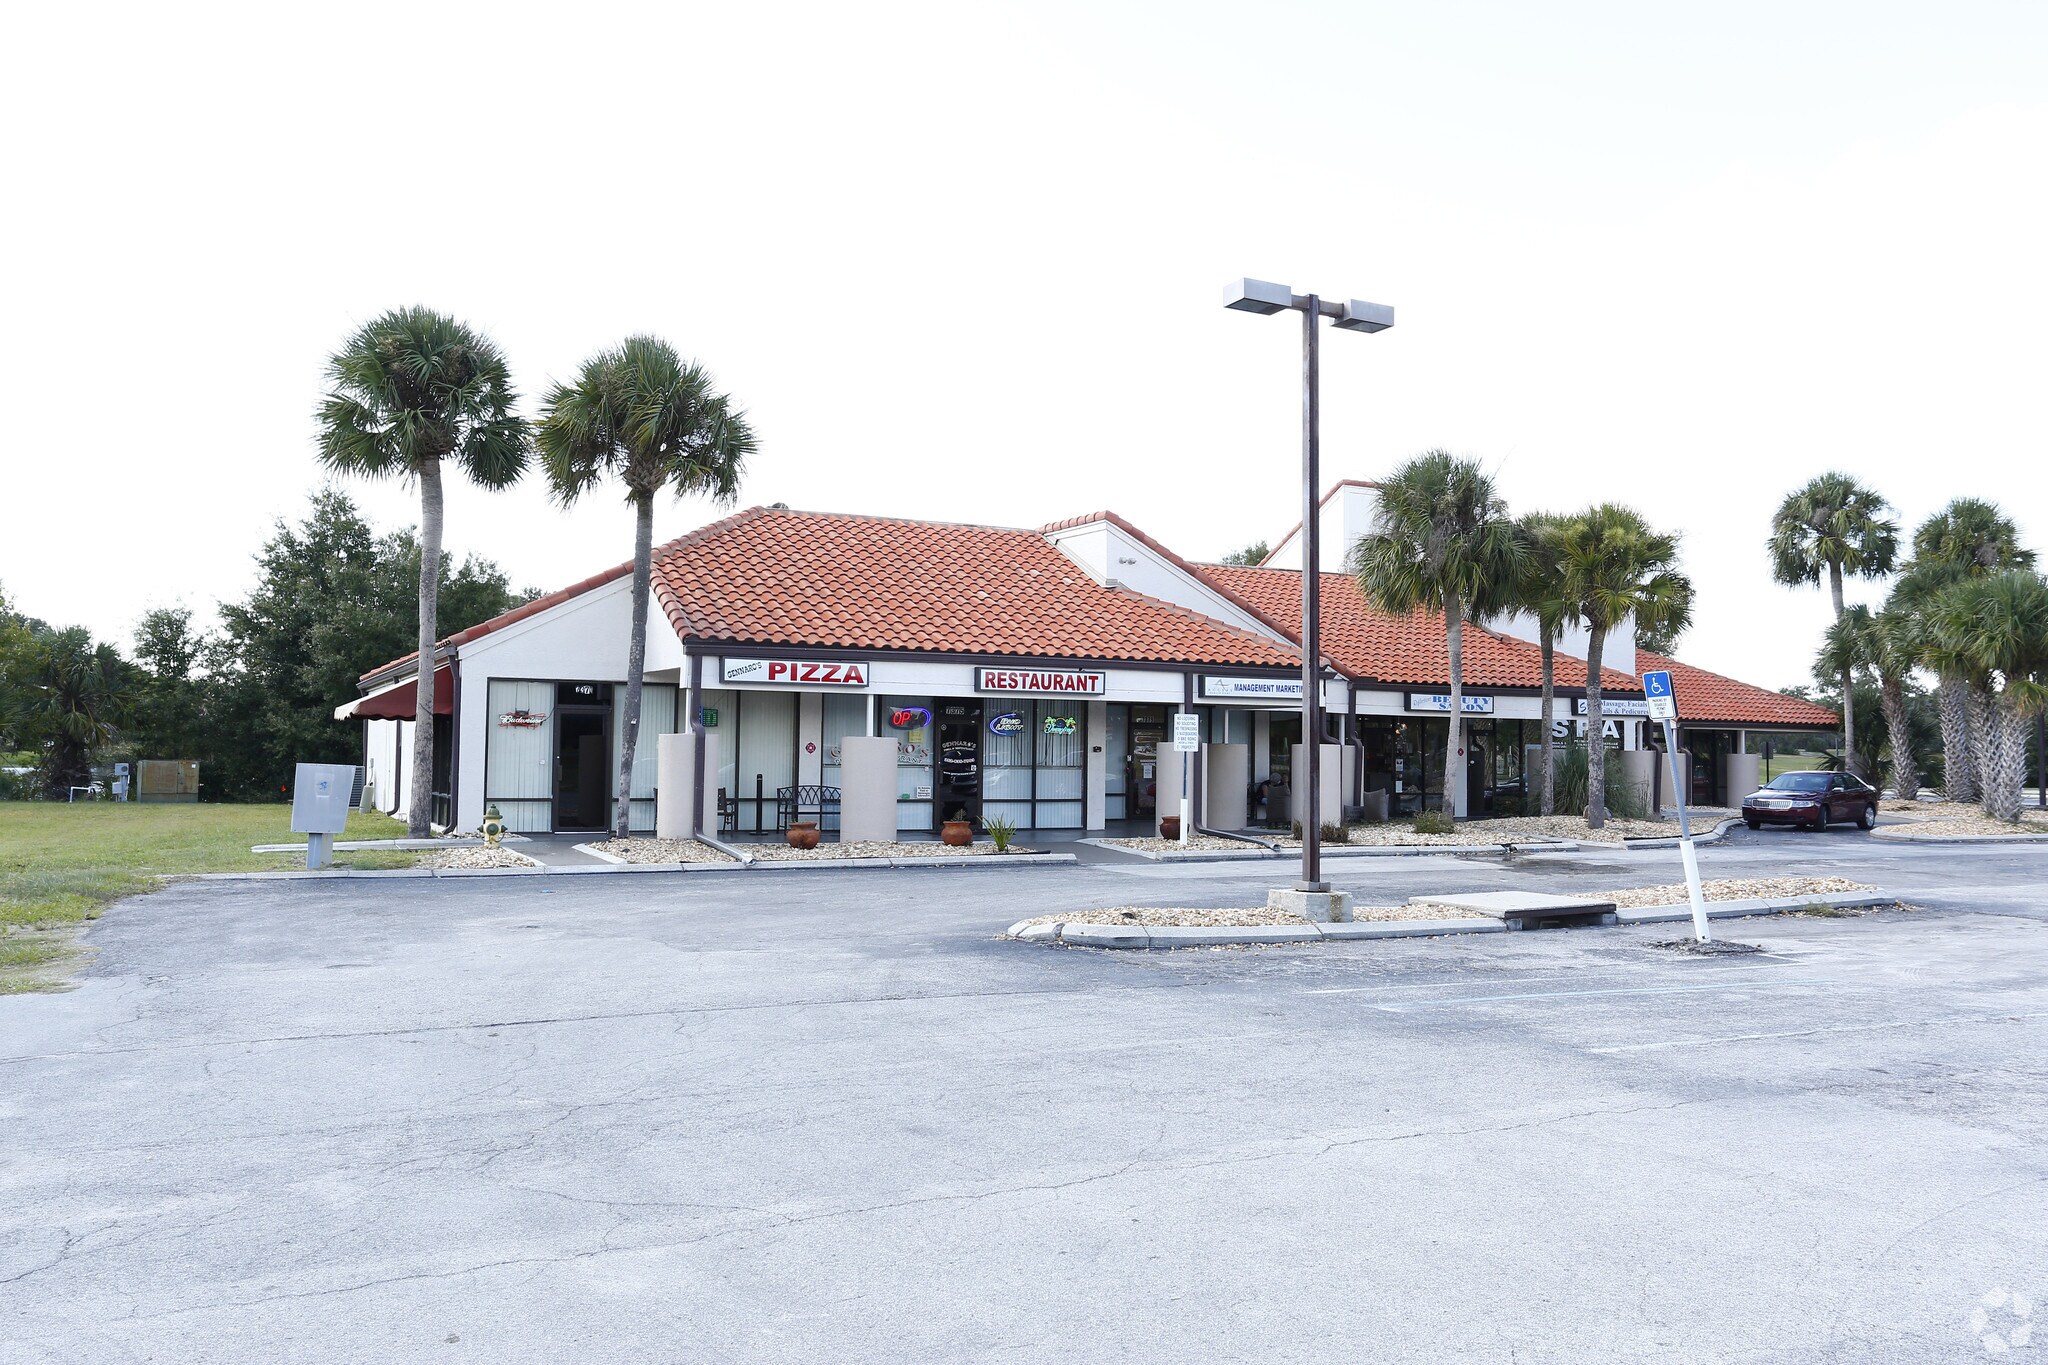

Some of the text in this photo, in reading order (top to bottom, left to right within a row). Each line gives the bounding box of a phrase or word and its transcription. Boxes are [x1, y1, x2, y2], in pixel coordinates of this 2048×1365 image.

[727, 661, 865, 684] GENNARO'S PIZZA
[984, 671, 1099, 692] RESTAURANT
[1234, 683, 1275, 693] MANAGEMENT
[1432, 695, 1491, 705] BEUTY
